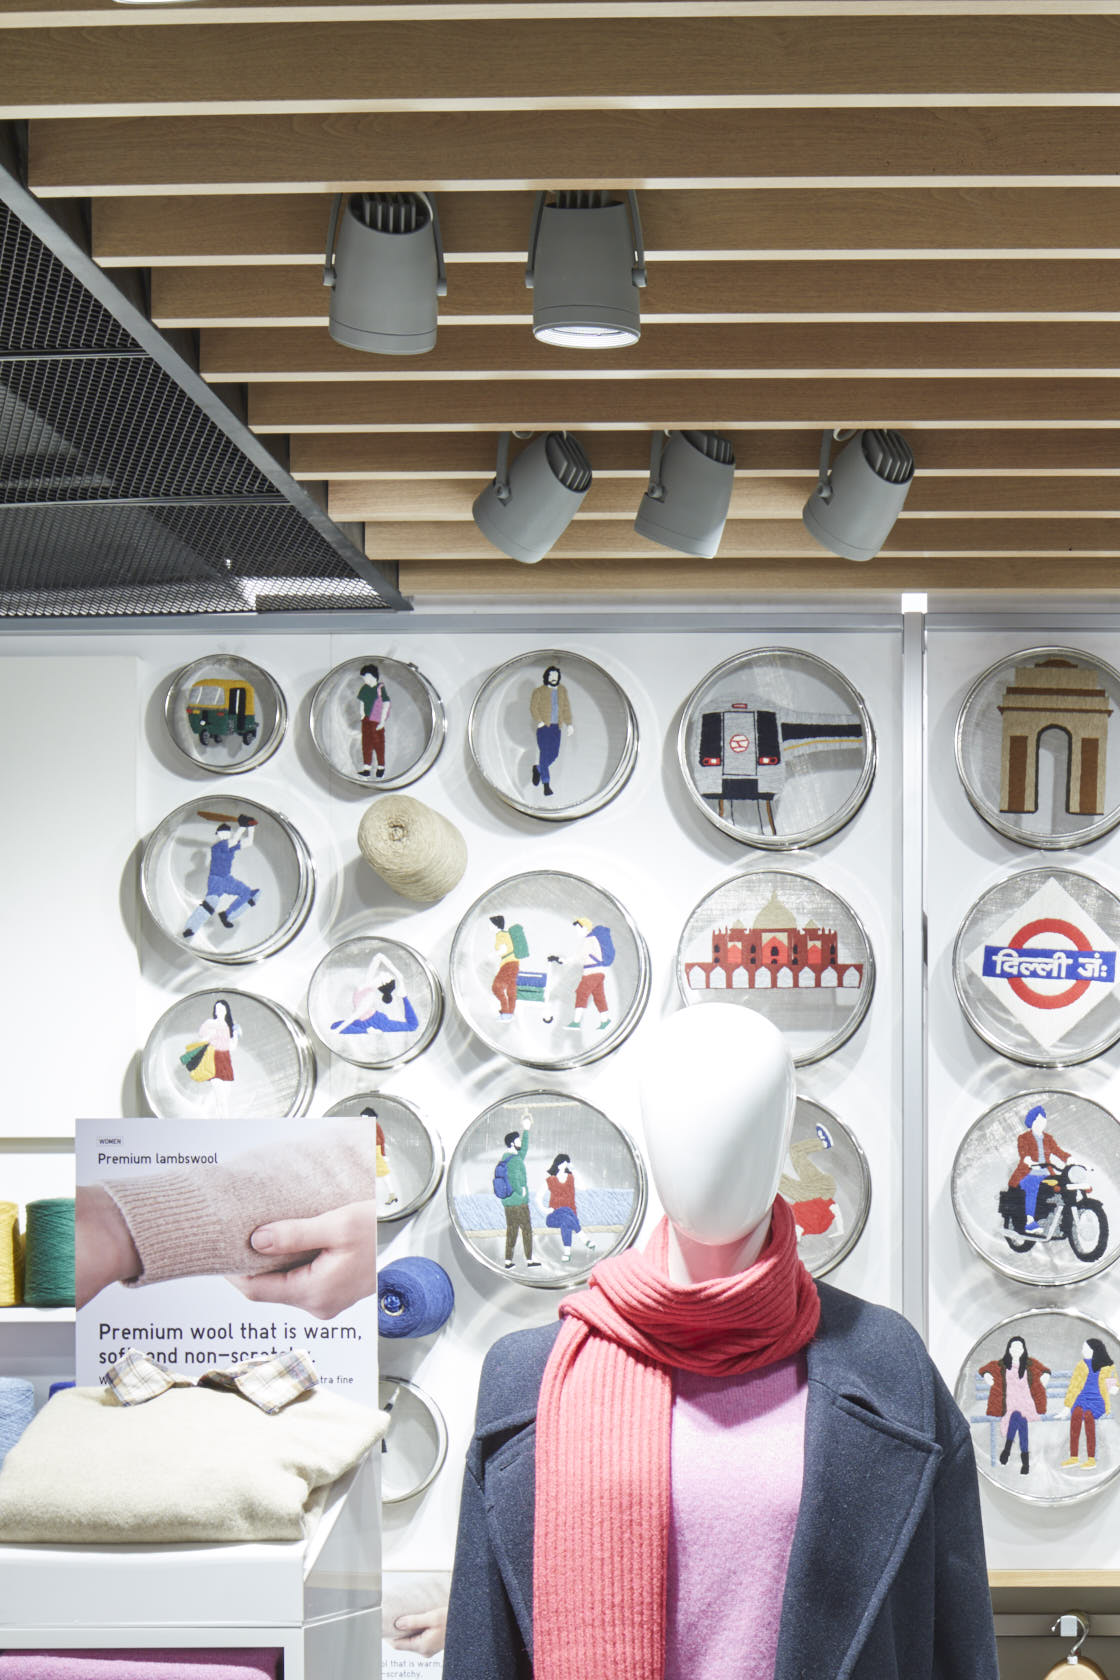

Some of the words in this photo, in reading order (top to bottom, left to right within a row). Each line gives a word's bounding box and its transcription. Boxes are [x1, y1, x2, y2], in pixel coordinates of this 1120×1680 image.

[992, 948, 1074, 979] दिल्ली
[98, 1153, 152, 1165] Premium
[155, 1153, 219, 1165] lambswool
[98, 1322, 184, 1340] Premium
[190, 1322, 234, 1340] wool
[240, 1322, 278, 1340] that
[284, 1322, 297, 1340] is
[304, 1326, 362, 1341] warm,
